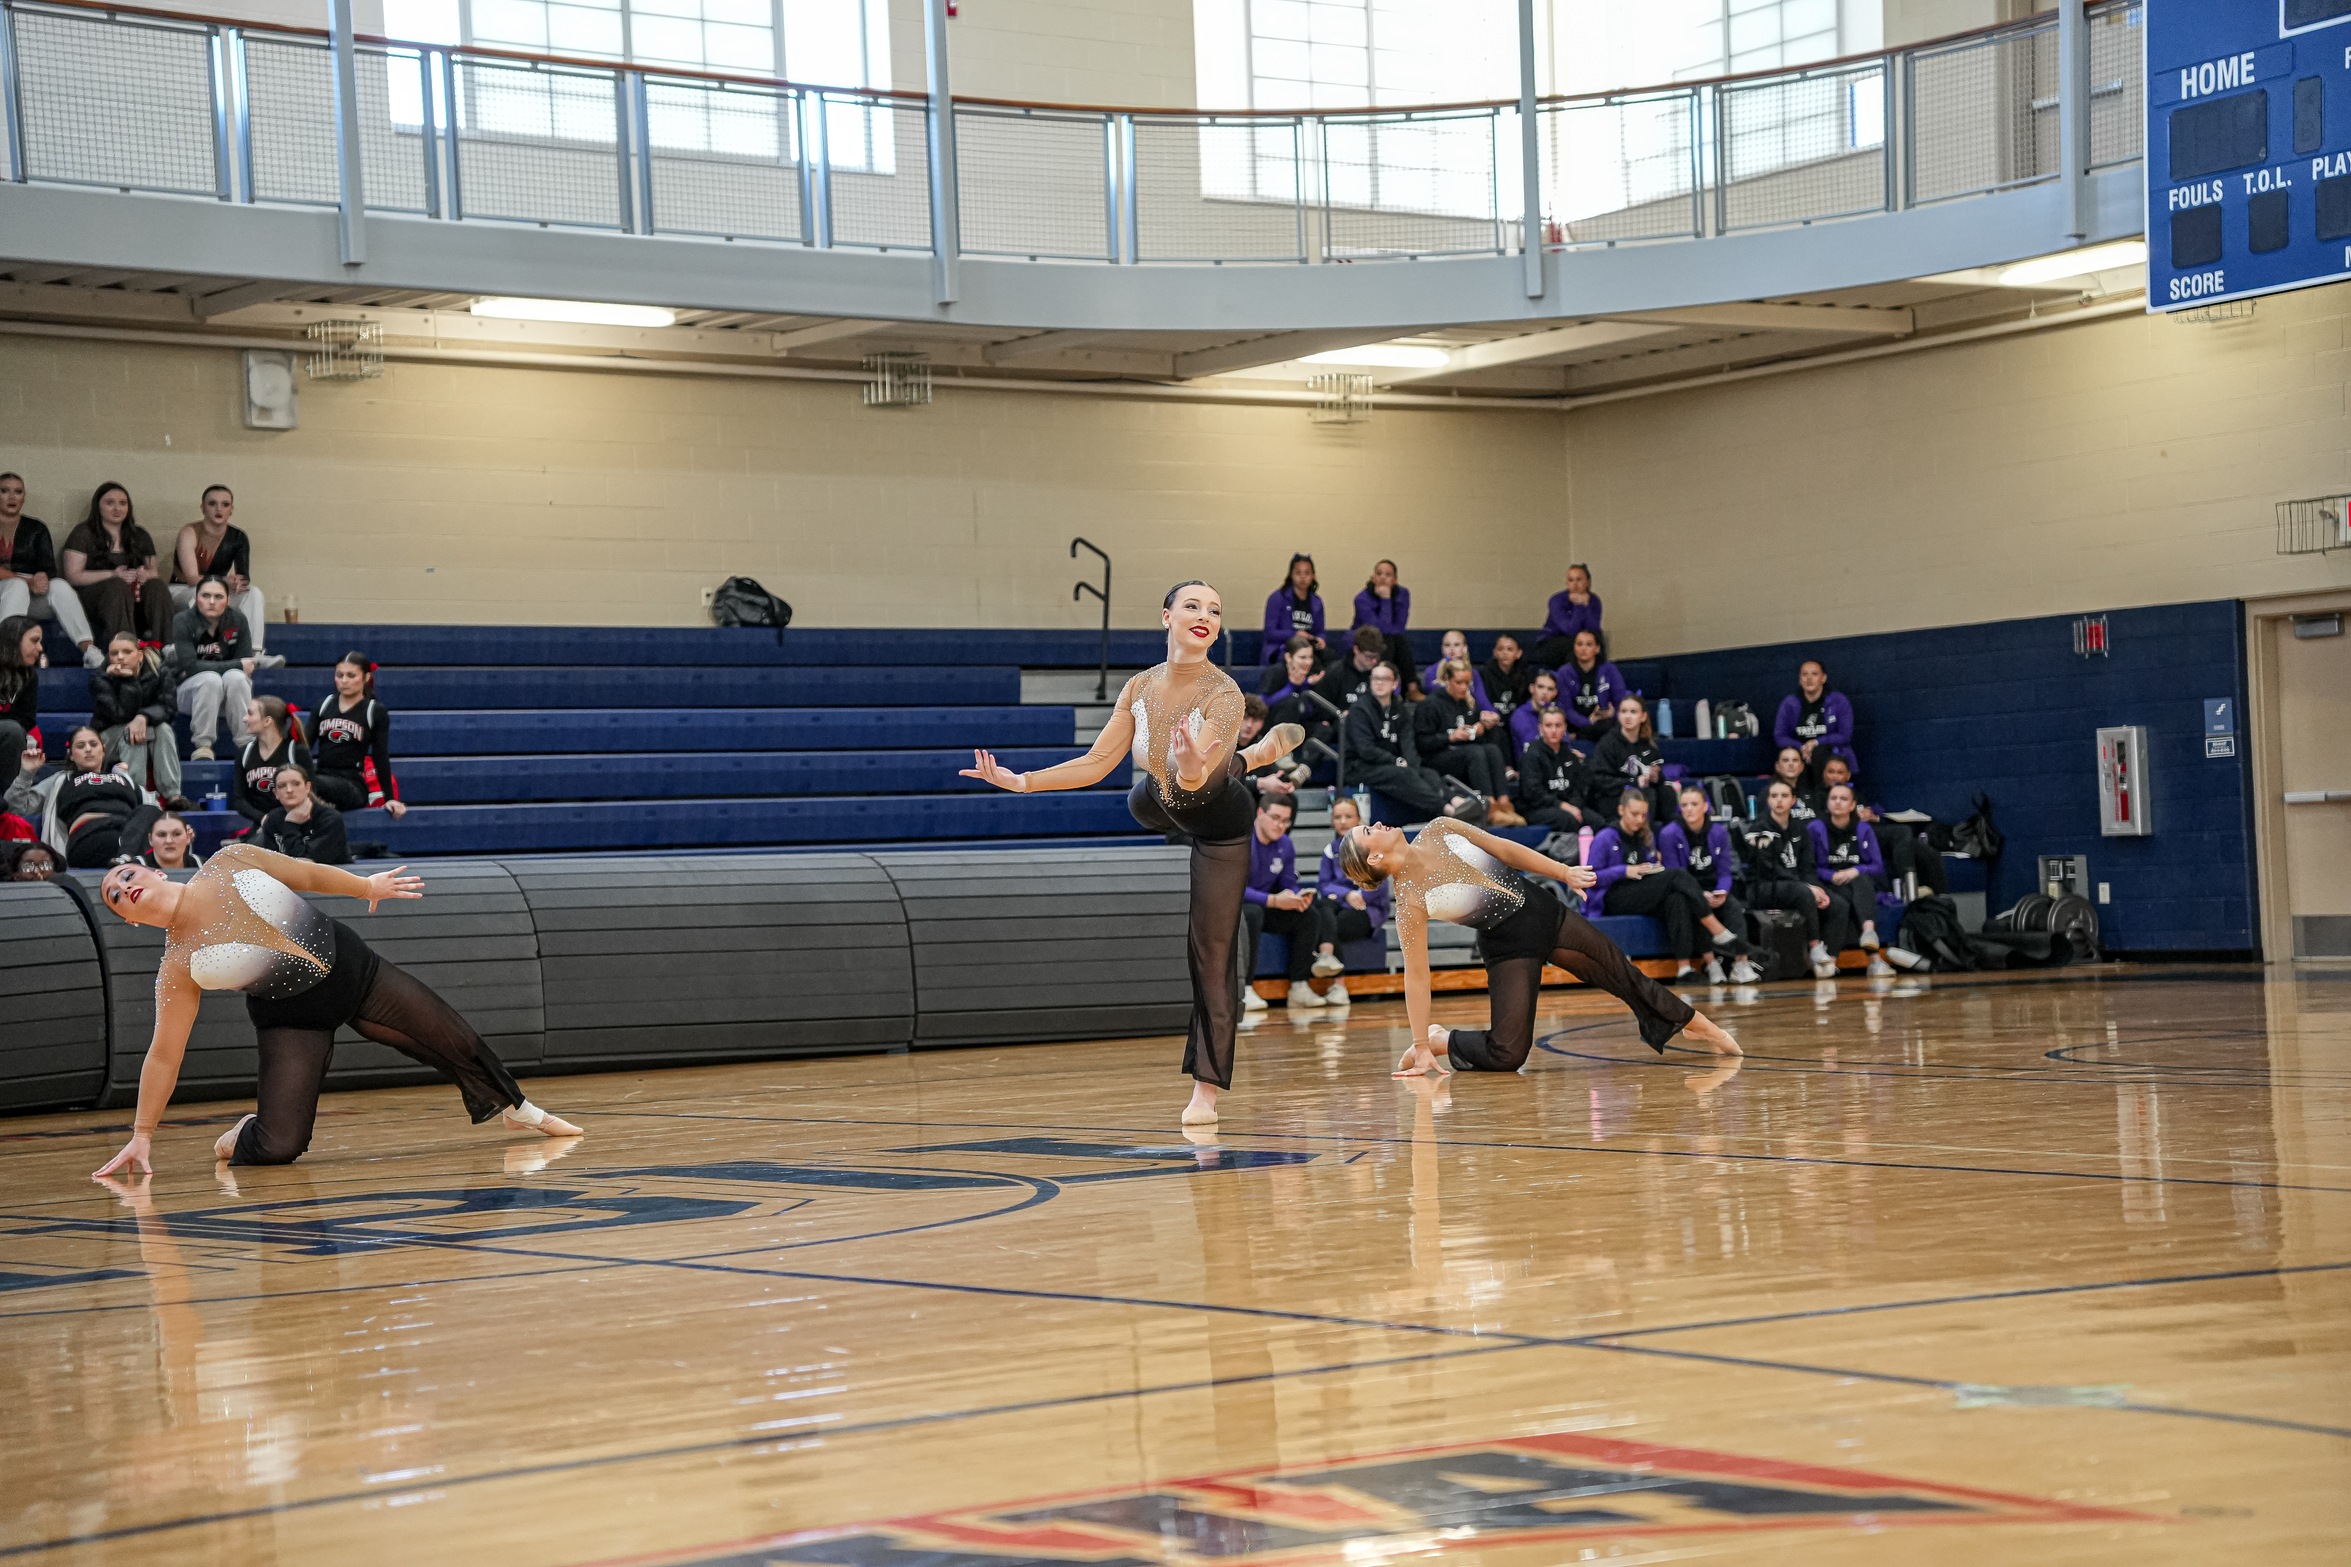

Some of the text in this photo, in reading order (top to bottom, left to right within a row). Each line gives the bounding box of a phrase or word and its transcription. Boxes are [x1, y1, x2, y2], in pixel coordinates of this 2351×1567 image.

[2181, 51, 2255, 100] HOME
[2169, 179, 2223, 211] FOULS
[2243, 166, 2292, 195] T.O.L.
[2170, 269, 2224, 300] SCORE
[319, 717, 363, 742] SIMPSON
